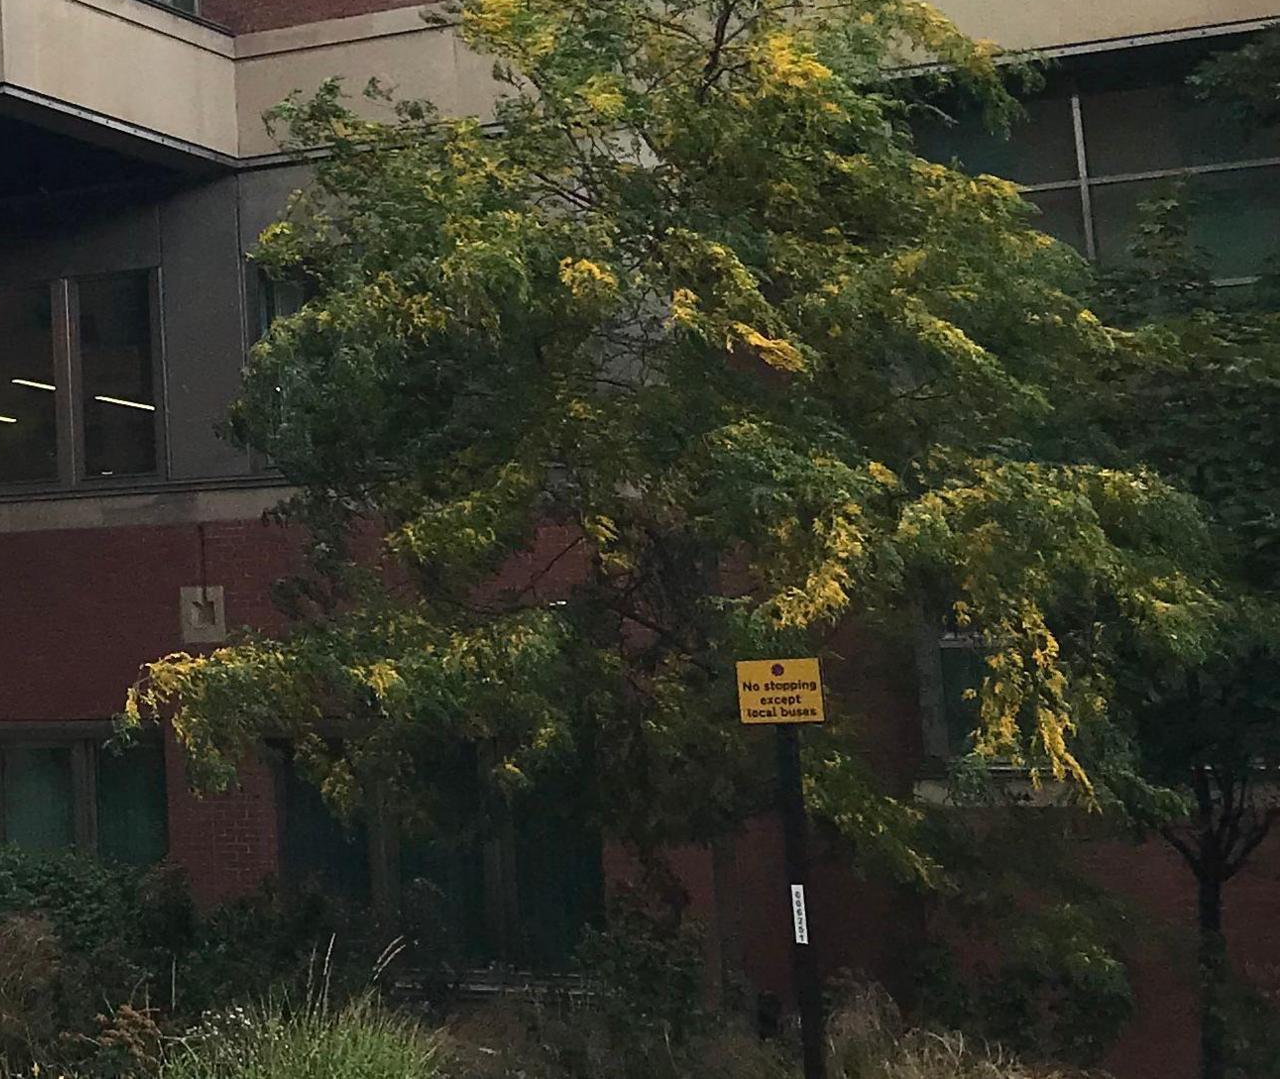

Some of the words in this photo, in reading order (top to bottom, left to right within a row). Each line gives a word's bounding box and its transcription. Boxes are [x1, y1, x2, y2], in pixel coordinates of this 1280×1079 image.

[743, 681, 760, 691] No
[764, 680, 817, 692] stopping
[760, 694, 801, 705] except
[747, 707, 777, 717] local
[780, 706, 816, 717] buses
